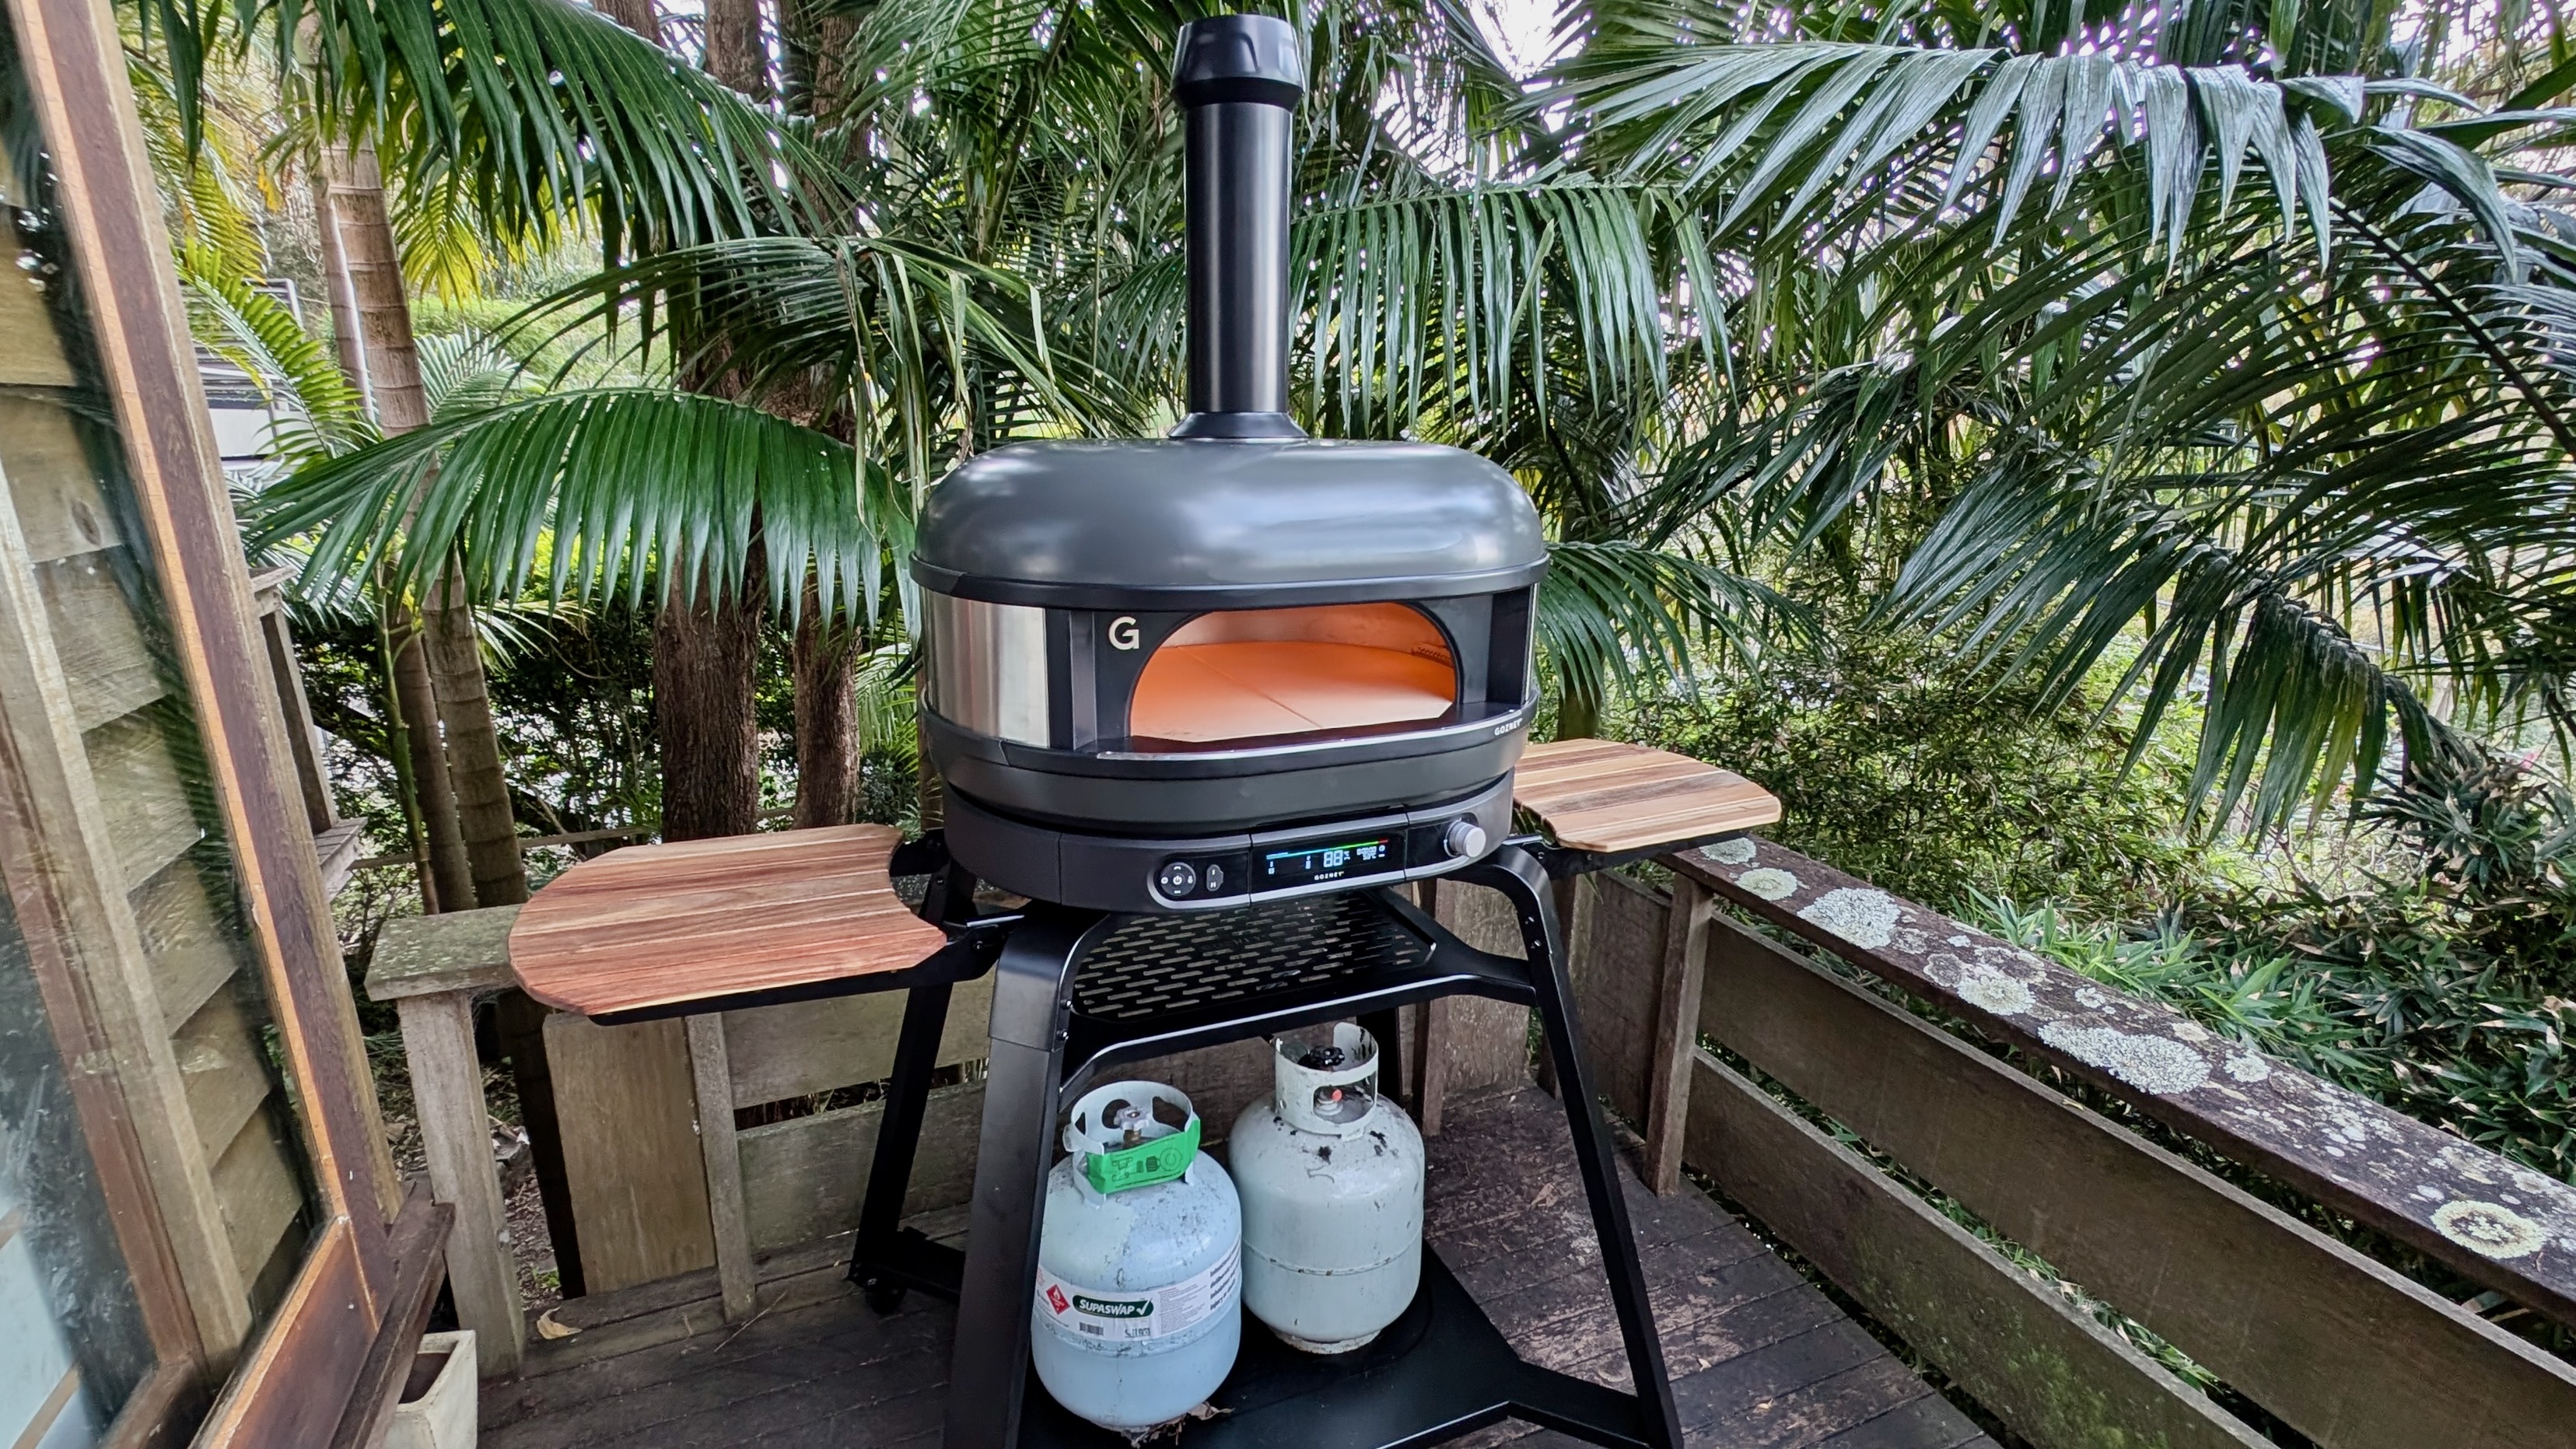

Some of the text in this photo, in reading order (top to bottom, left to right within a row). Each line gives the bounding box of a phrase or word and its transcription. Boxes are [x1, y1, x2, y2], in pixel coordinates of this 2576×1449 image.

[1108, 616, 1139, 650] G
[1494, 717, 1522, 736] GOZNEY
[1314, 871, 1343, 880] GOZNEY
[1080, 1299, 1136, 1316] SUPASWAP
